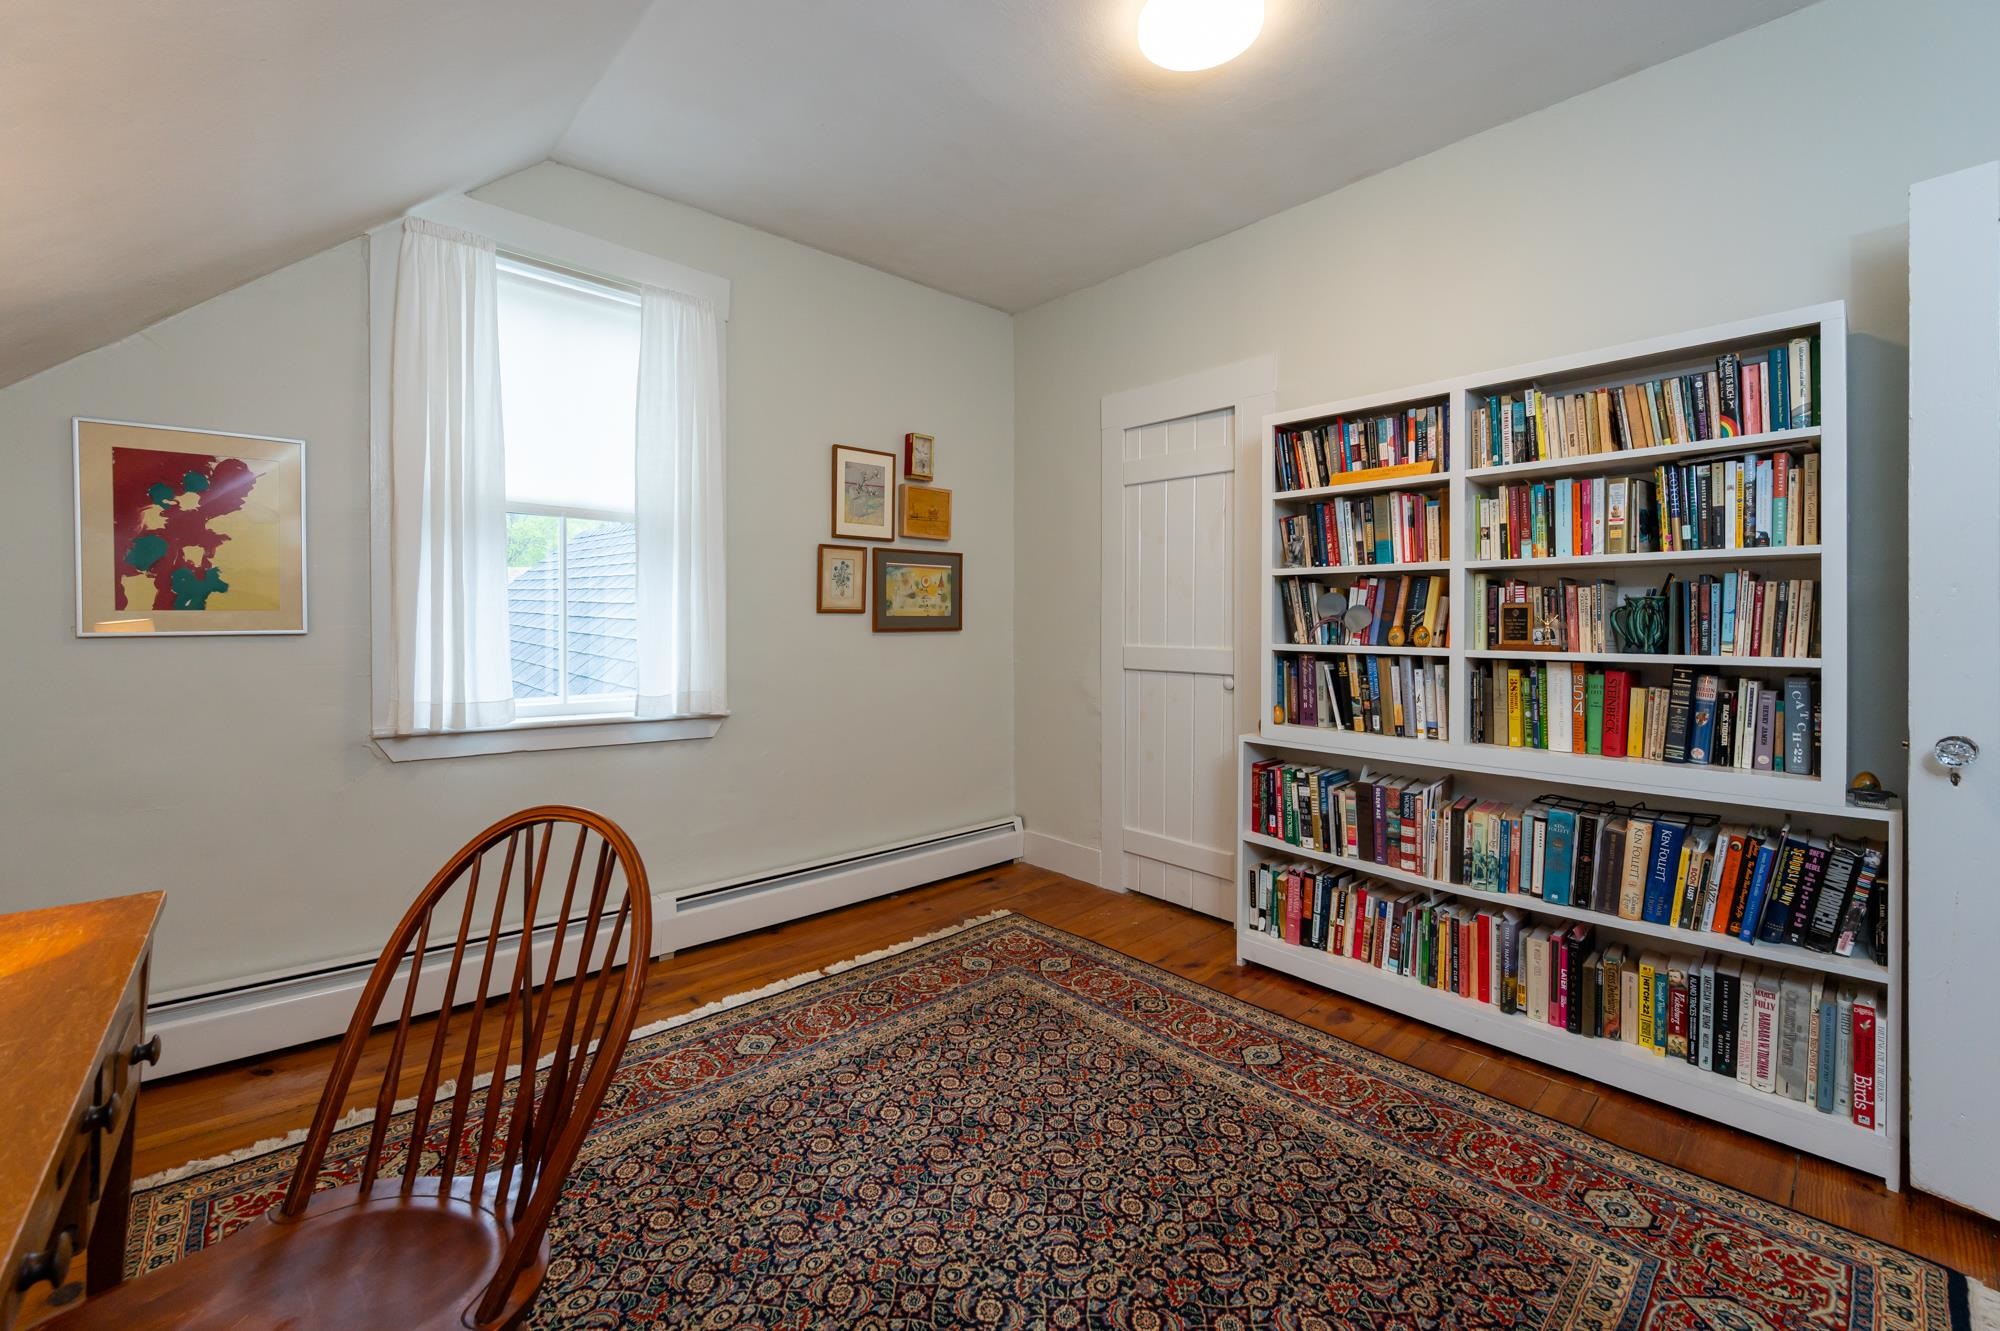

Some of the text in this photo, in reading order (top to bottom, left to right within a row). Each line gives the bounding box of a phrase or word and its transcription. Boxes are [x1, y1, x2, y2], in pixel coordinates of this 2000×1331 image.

[1726, 384, 1734, 399] RICH
[1668, 471, 1680, 514] COYOTE
[1807, 502, 1815, 517] Good
[1510, 678, 1518, 692] 38
[1605, 678, 1617, 734] STEINBECK
[1760, 726, 1769, 746] JAMES
[1791, 690, 1809, 764] CATCH-22
[1628, 828, 1644, 880] KEN FOLLETT
[1655, 829, 1672, 883] KEN FOLLETT
[1779, 848, 1805, 906] SERIOUSLY FUNNY
[1805, 862, 1821, 872] REBEL
[1686, 867, 1698, 901] BOOK LUST
[1706, 880, 1719, 904] JAZZ
[1739, 888, 1748, 903] Changed
[1811, 854, 1855, 933] LENNY BRUCE!!
[1560, 968, 1568, 990] LATER
[1703, 975, 1712, 1001] AMERICAN
[1643, 977, 1651, 1015] HITCH-22
[1688, 977, 1698, 1016] ALAMO TRACES
[1754, 989, 1776, 1000] MARCH
[1754, 1000, 1776, 1011] FOLLY
[1670, 991, 1686, 1025] Vicksburg
[1702, 1001, 1712, 1014] TIME
[1825, 1006, 1833, 1022] NORTH
[1702, 1014, 1711, 1030] BOMB
[1757, 1012, 1771, 1042] BARBARA
[1810, 1013, 1819, 1037] BACKYARD
[1841, 1012, 1851, 1035] BIRD
[1824, 1023, 1832, 1048] AMERICAN
[1756, 1049, 1770, 1080] TUCHMAN
[1823, 1049, 1831, 1063] BIRDS
[1808, 1068, 1817, 1082] GUIDE
[1822, 1070, 1830, 1082] PREY
[1854, 1073, 1874, 1110] Birds
